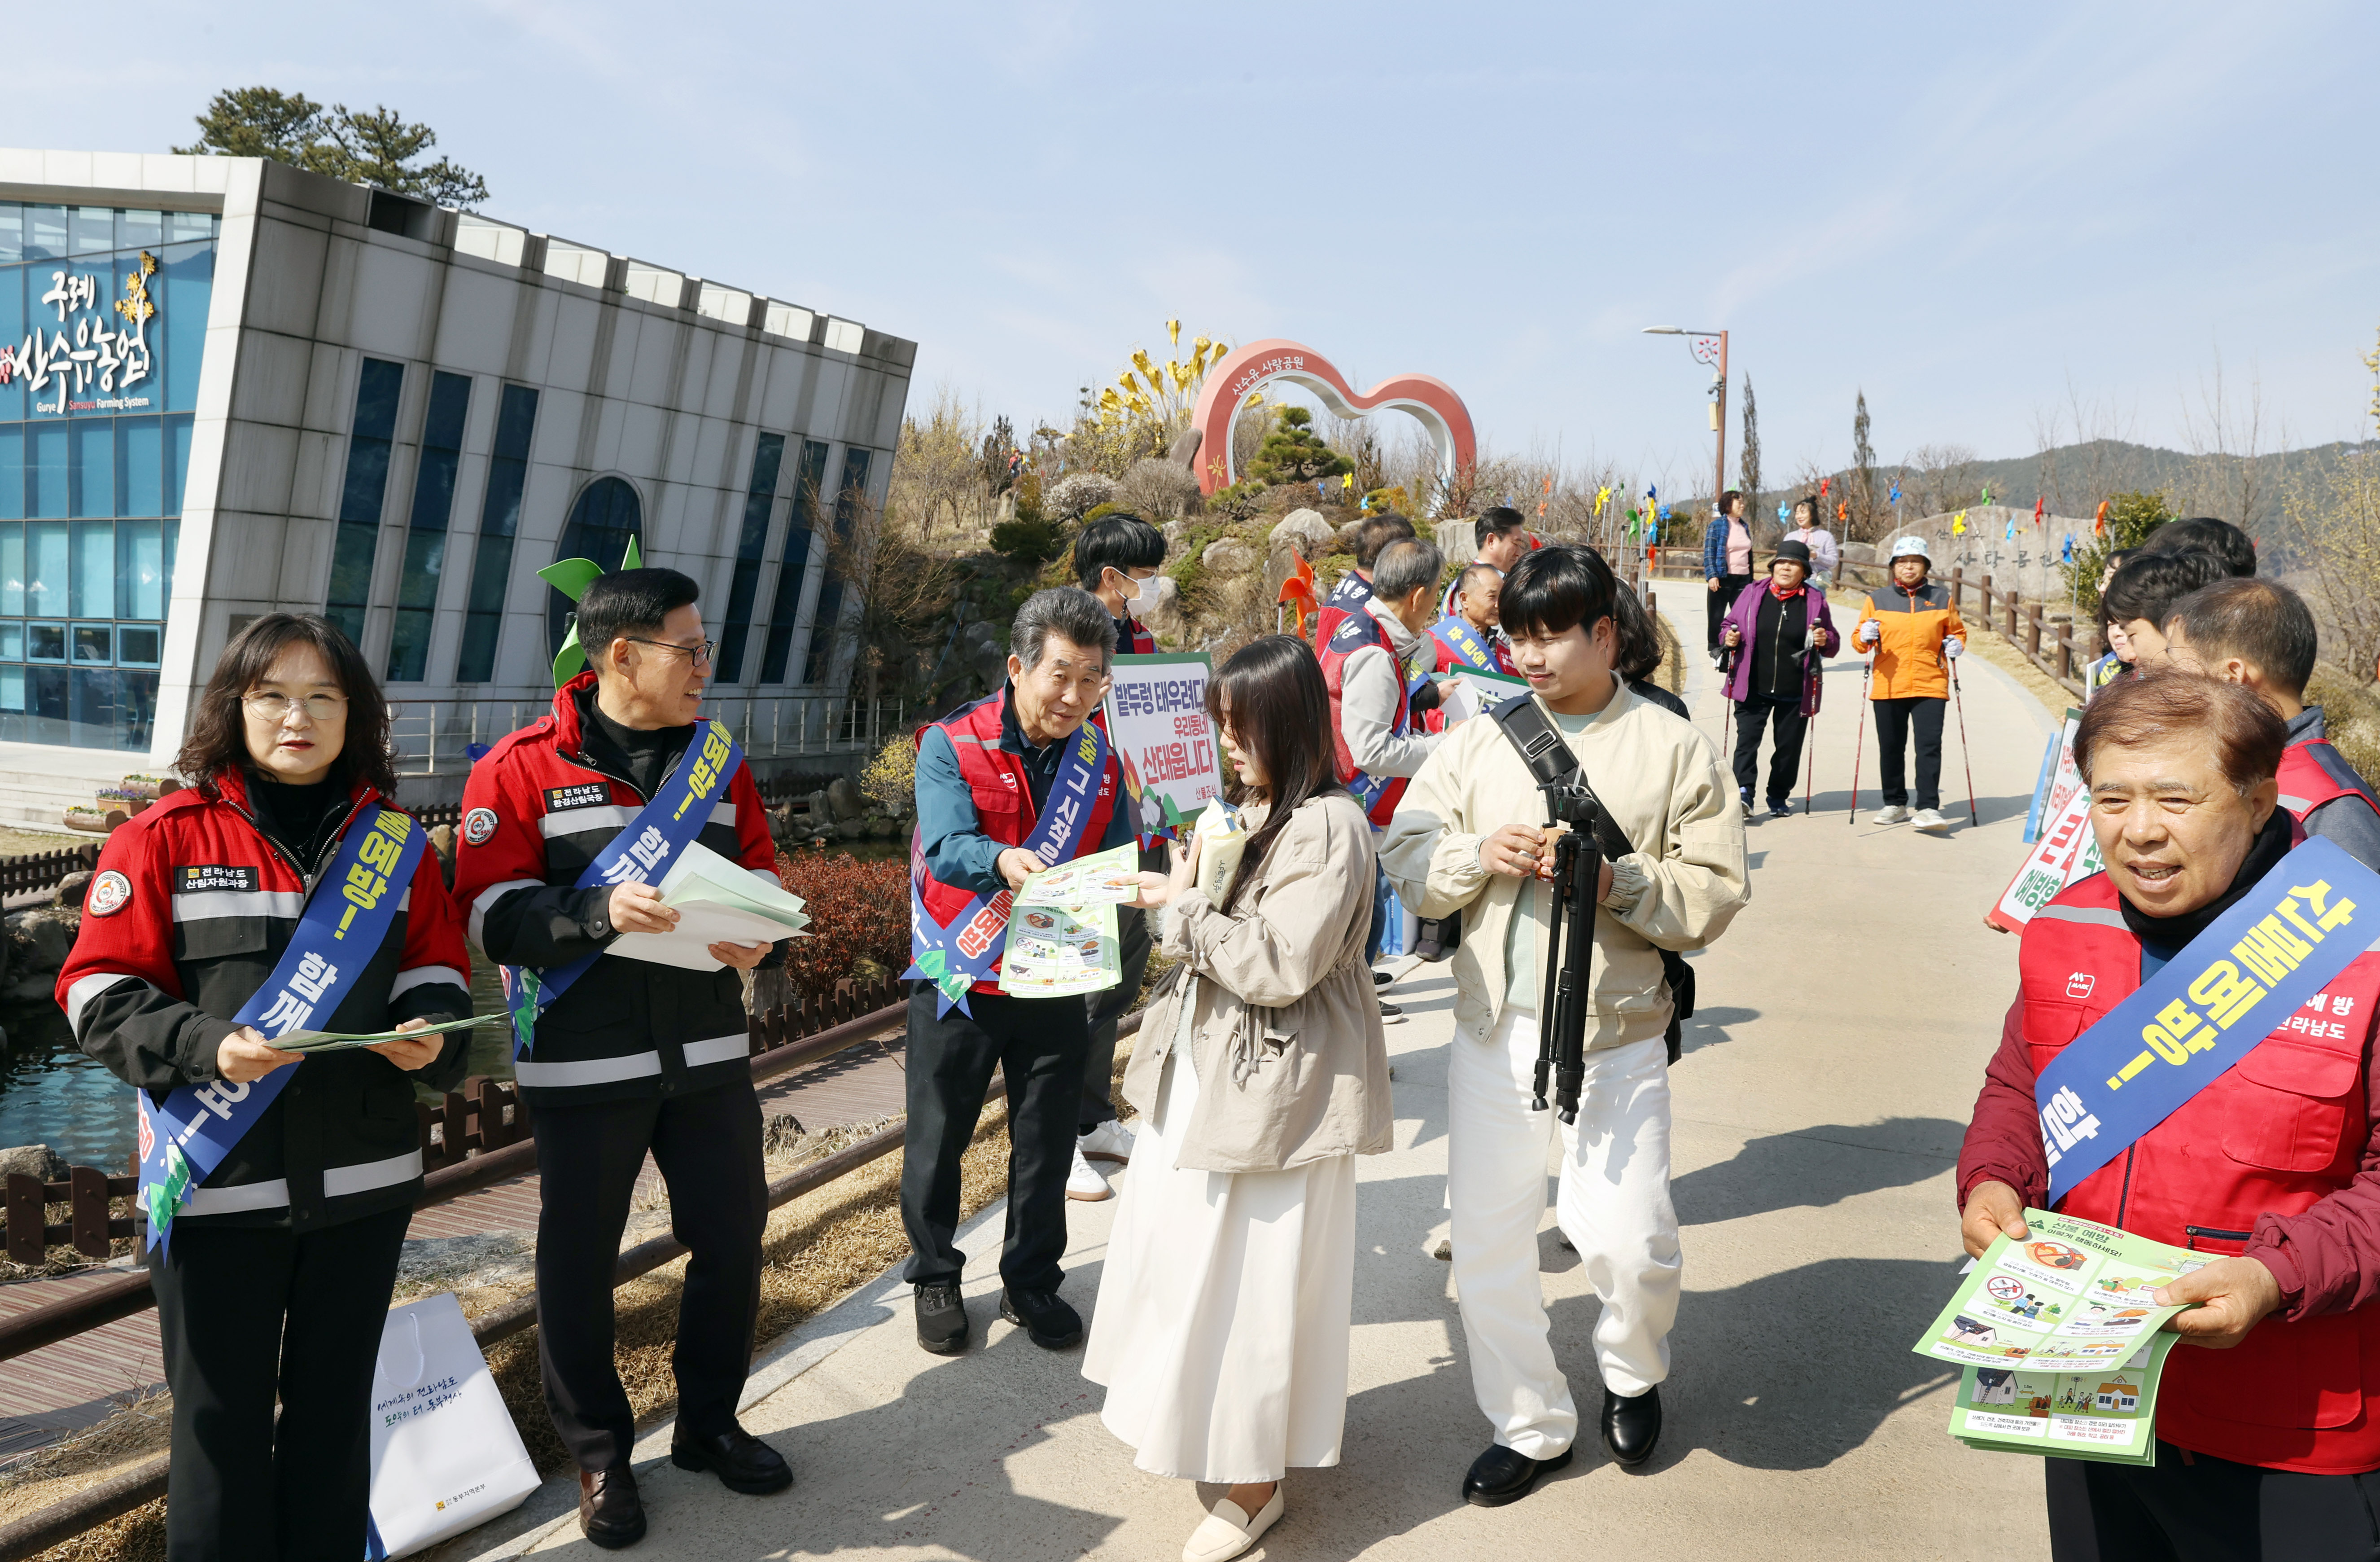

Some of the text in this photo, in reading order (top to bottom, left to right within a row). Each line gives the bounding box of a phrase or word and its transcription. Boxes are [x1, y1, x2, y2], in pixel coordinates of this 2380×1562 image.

[42, 270, 96, 322] 구례
[13, 316, 149, 414] 산수유농업
[1233, 356, 1303, 396] 산수유 사랑공원
[36, 396, 149, 413] Gurye Sansuyu Farming System
[1114, 678, 1205, 717] 밭두렁 태우려다
[1174, 712, 1209, 739] 우리동네
[553, 794, 604, 807] 환경산림국장
[564, 785, 600, 797] 전라남도
[1196, 785, 1216, 800] 산불조심
[186, 878, 249, 889] 산림자원과장
[202, 868, 246, 878] 전라남도
[2106, 879, 2357, 1091] 산불예방!
[2047, 1229, 2122, 1258] 이렇게 행동하세요!
[2052, 1222, 2110, 1244] 산불 예방
[417, 1376, 458, 1397] 전라남도
[385, 1390, 462, 1428] 도약의 터 동부청사
[452, 1483, 486, 1503] 동부지역본부
